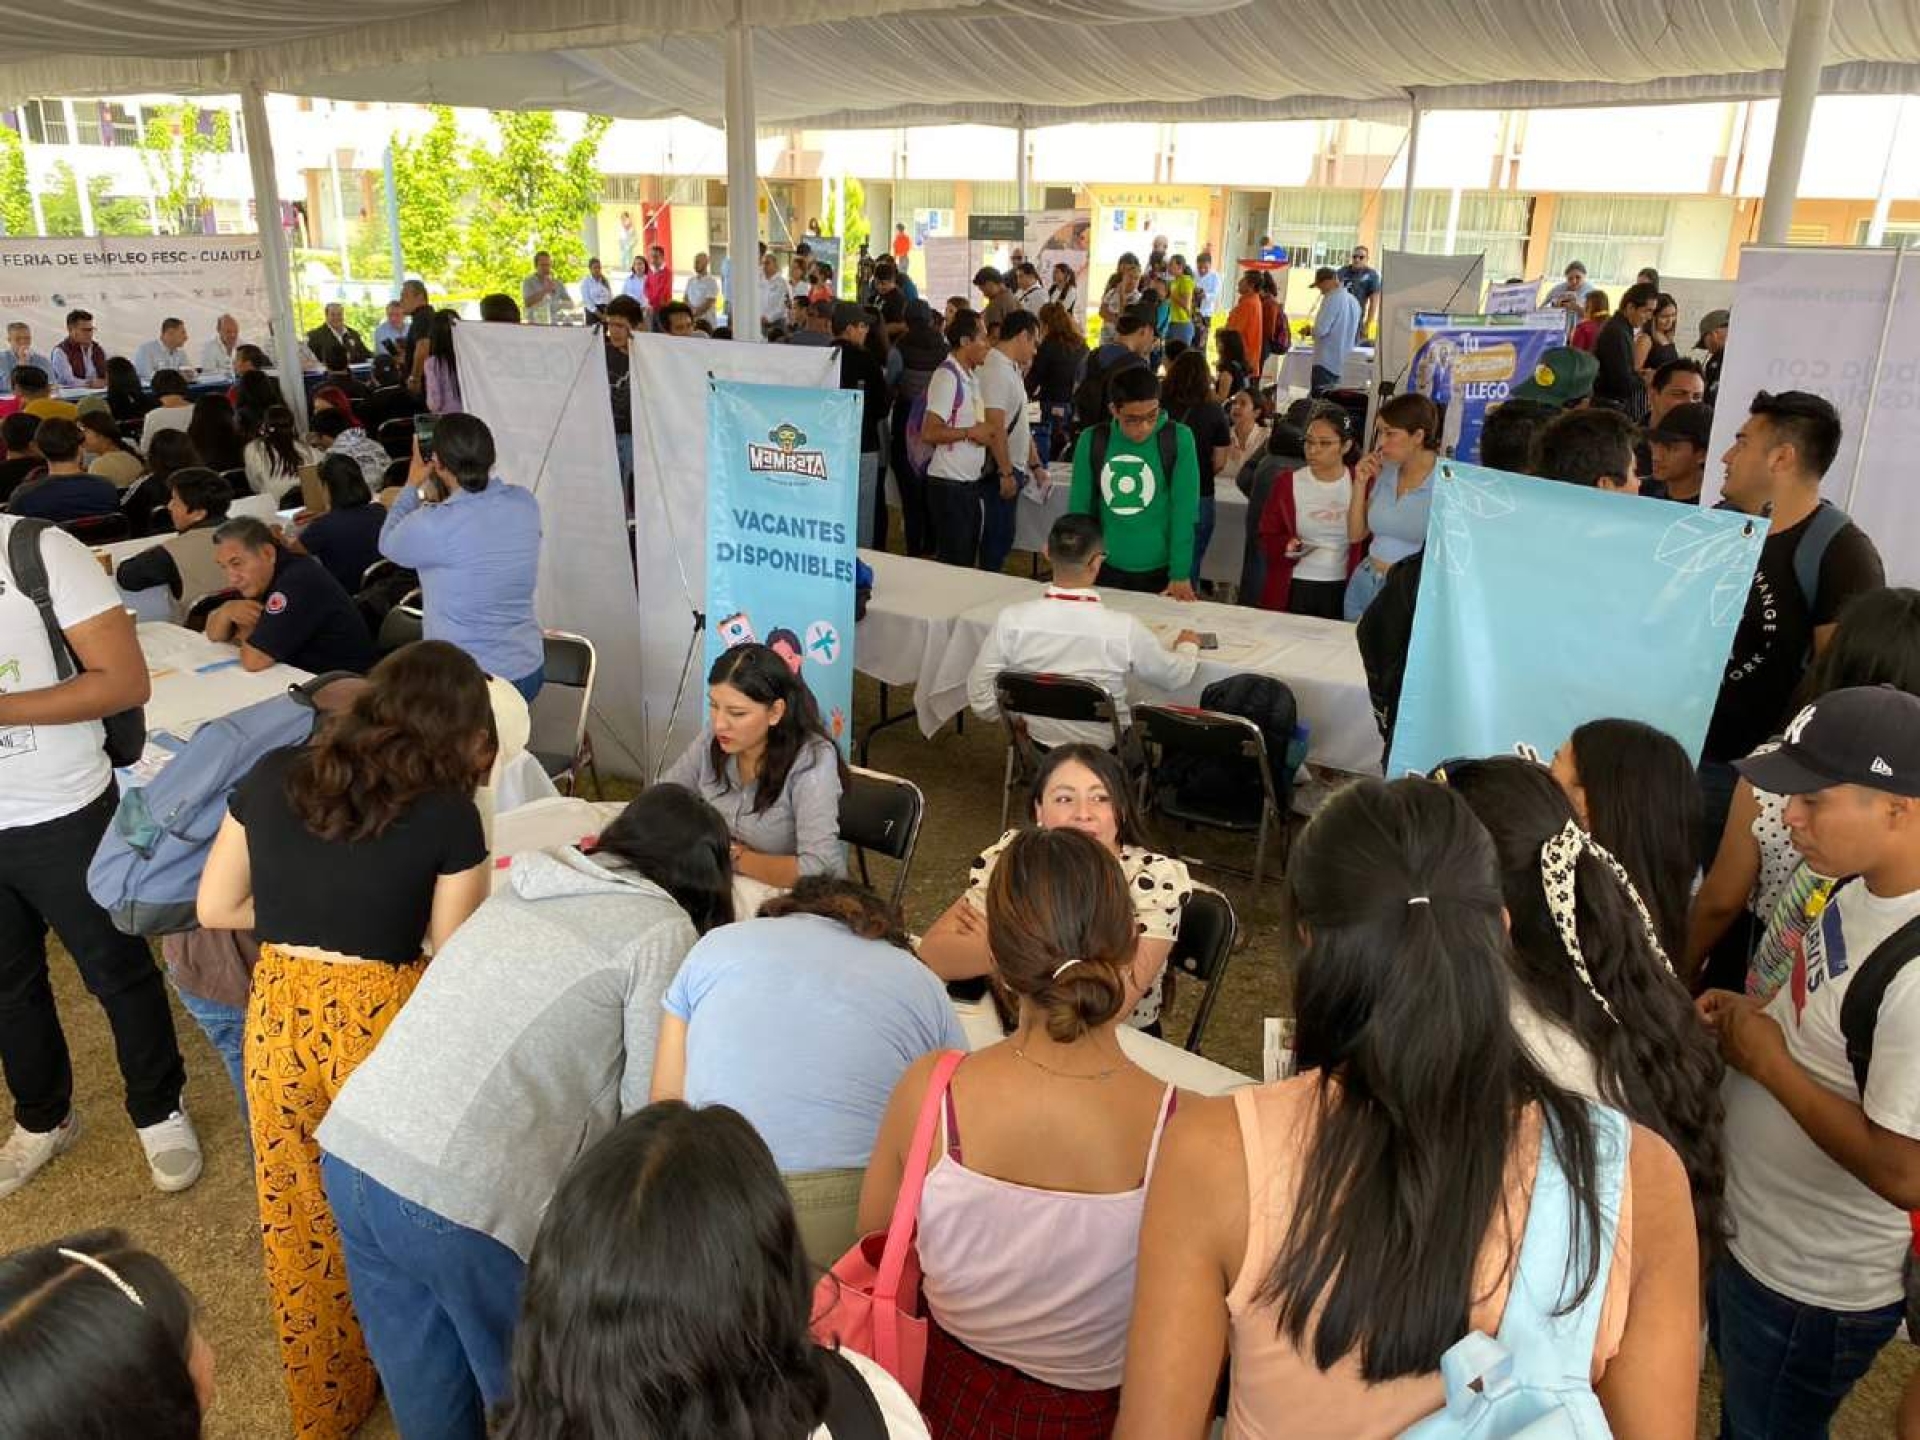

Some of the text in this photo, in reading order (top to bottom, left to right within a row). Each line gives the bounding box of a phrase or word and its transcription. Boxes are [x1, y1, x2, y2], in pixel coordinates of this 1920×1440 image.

[2, 253, 52, 267] FERIA
[57, 253, 79, 265] DE
[83, 252, 148, 265] EMPLEO
[151, 250, 188, 263] FESC
[200, 249, 262, 261] CUAUTLA
[1465, 381, 1510, 399] LLEGO
[733, 509, 846, 544] VACANTES
[717, 543, 853, 582] DISPONIBLES
[1754, 571, 1777, 632] HANGE
